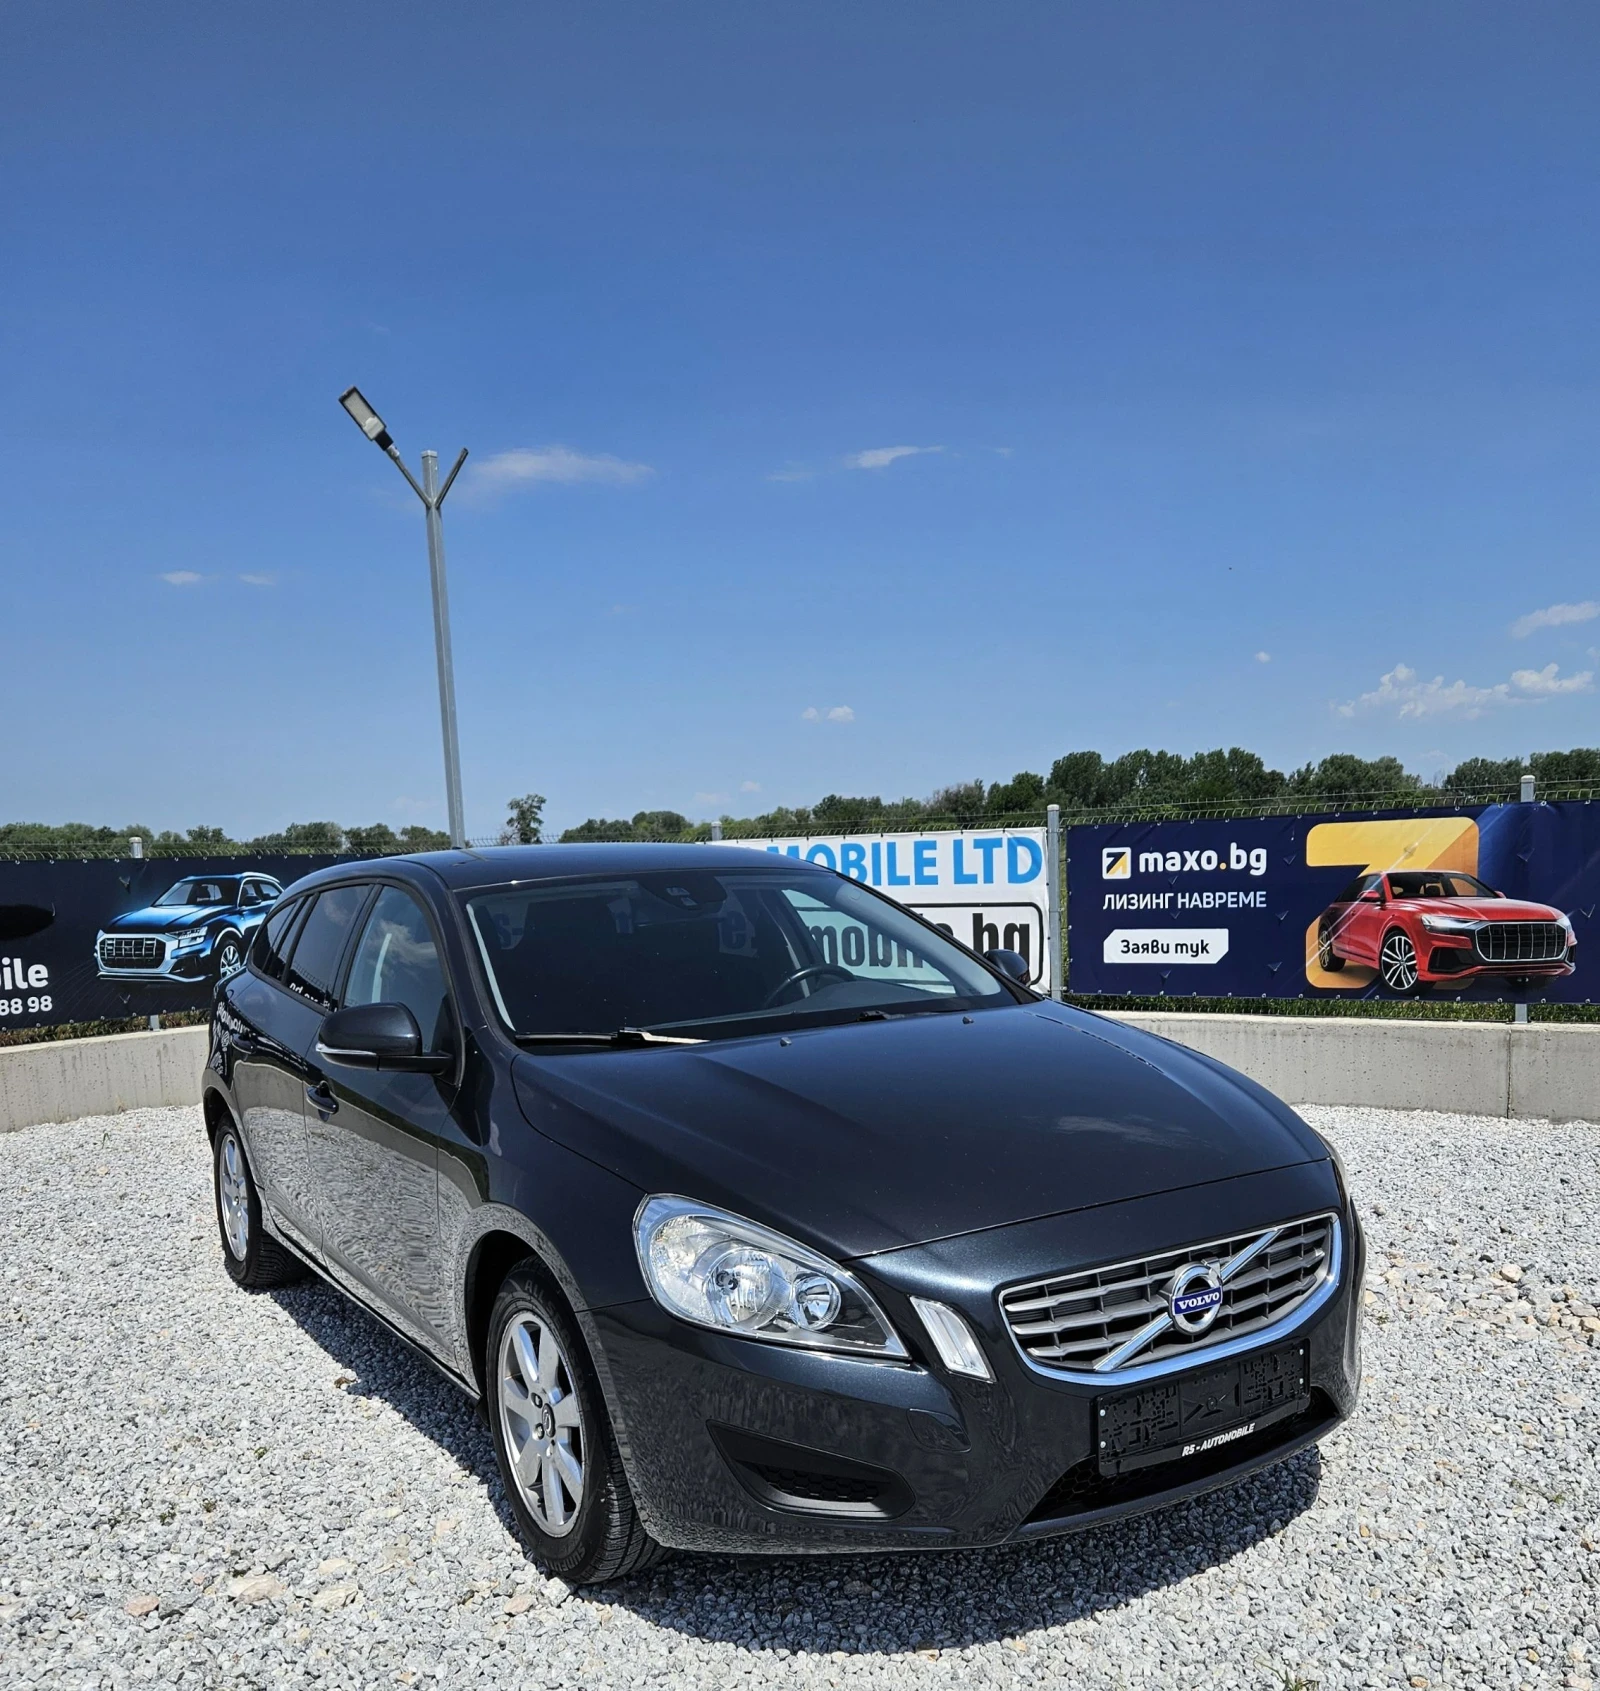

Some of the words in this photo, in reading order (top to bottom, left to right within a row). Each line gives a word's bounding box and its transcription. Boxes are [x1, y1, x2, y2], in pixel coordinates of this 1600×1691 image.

[953, 836, 1044, 885] LTD
[1139, 842, 1267, 876] maxo.bg
[1103, 893, 1174, 910] ЛИЗИНГ
[1177, 891, 1267, 909] НАВРЕМЕ
[1120, 939, 1170, 954] Заяви
[1174, 939, 1210, 958] тук
[0, 957, 49, 990] ile
[0, 999, 23, 1016] 88
[27, 995, 53, 1012] 98
[1177, 1291, 1220, 1310] VOLVO
[1200, 1422, 1256, 1451] AUTOMOBILE
